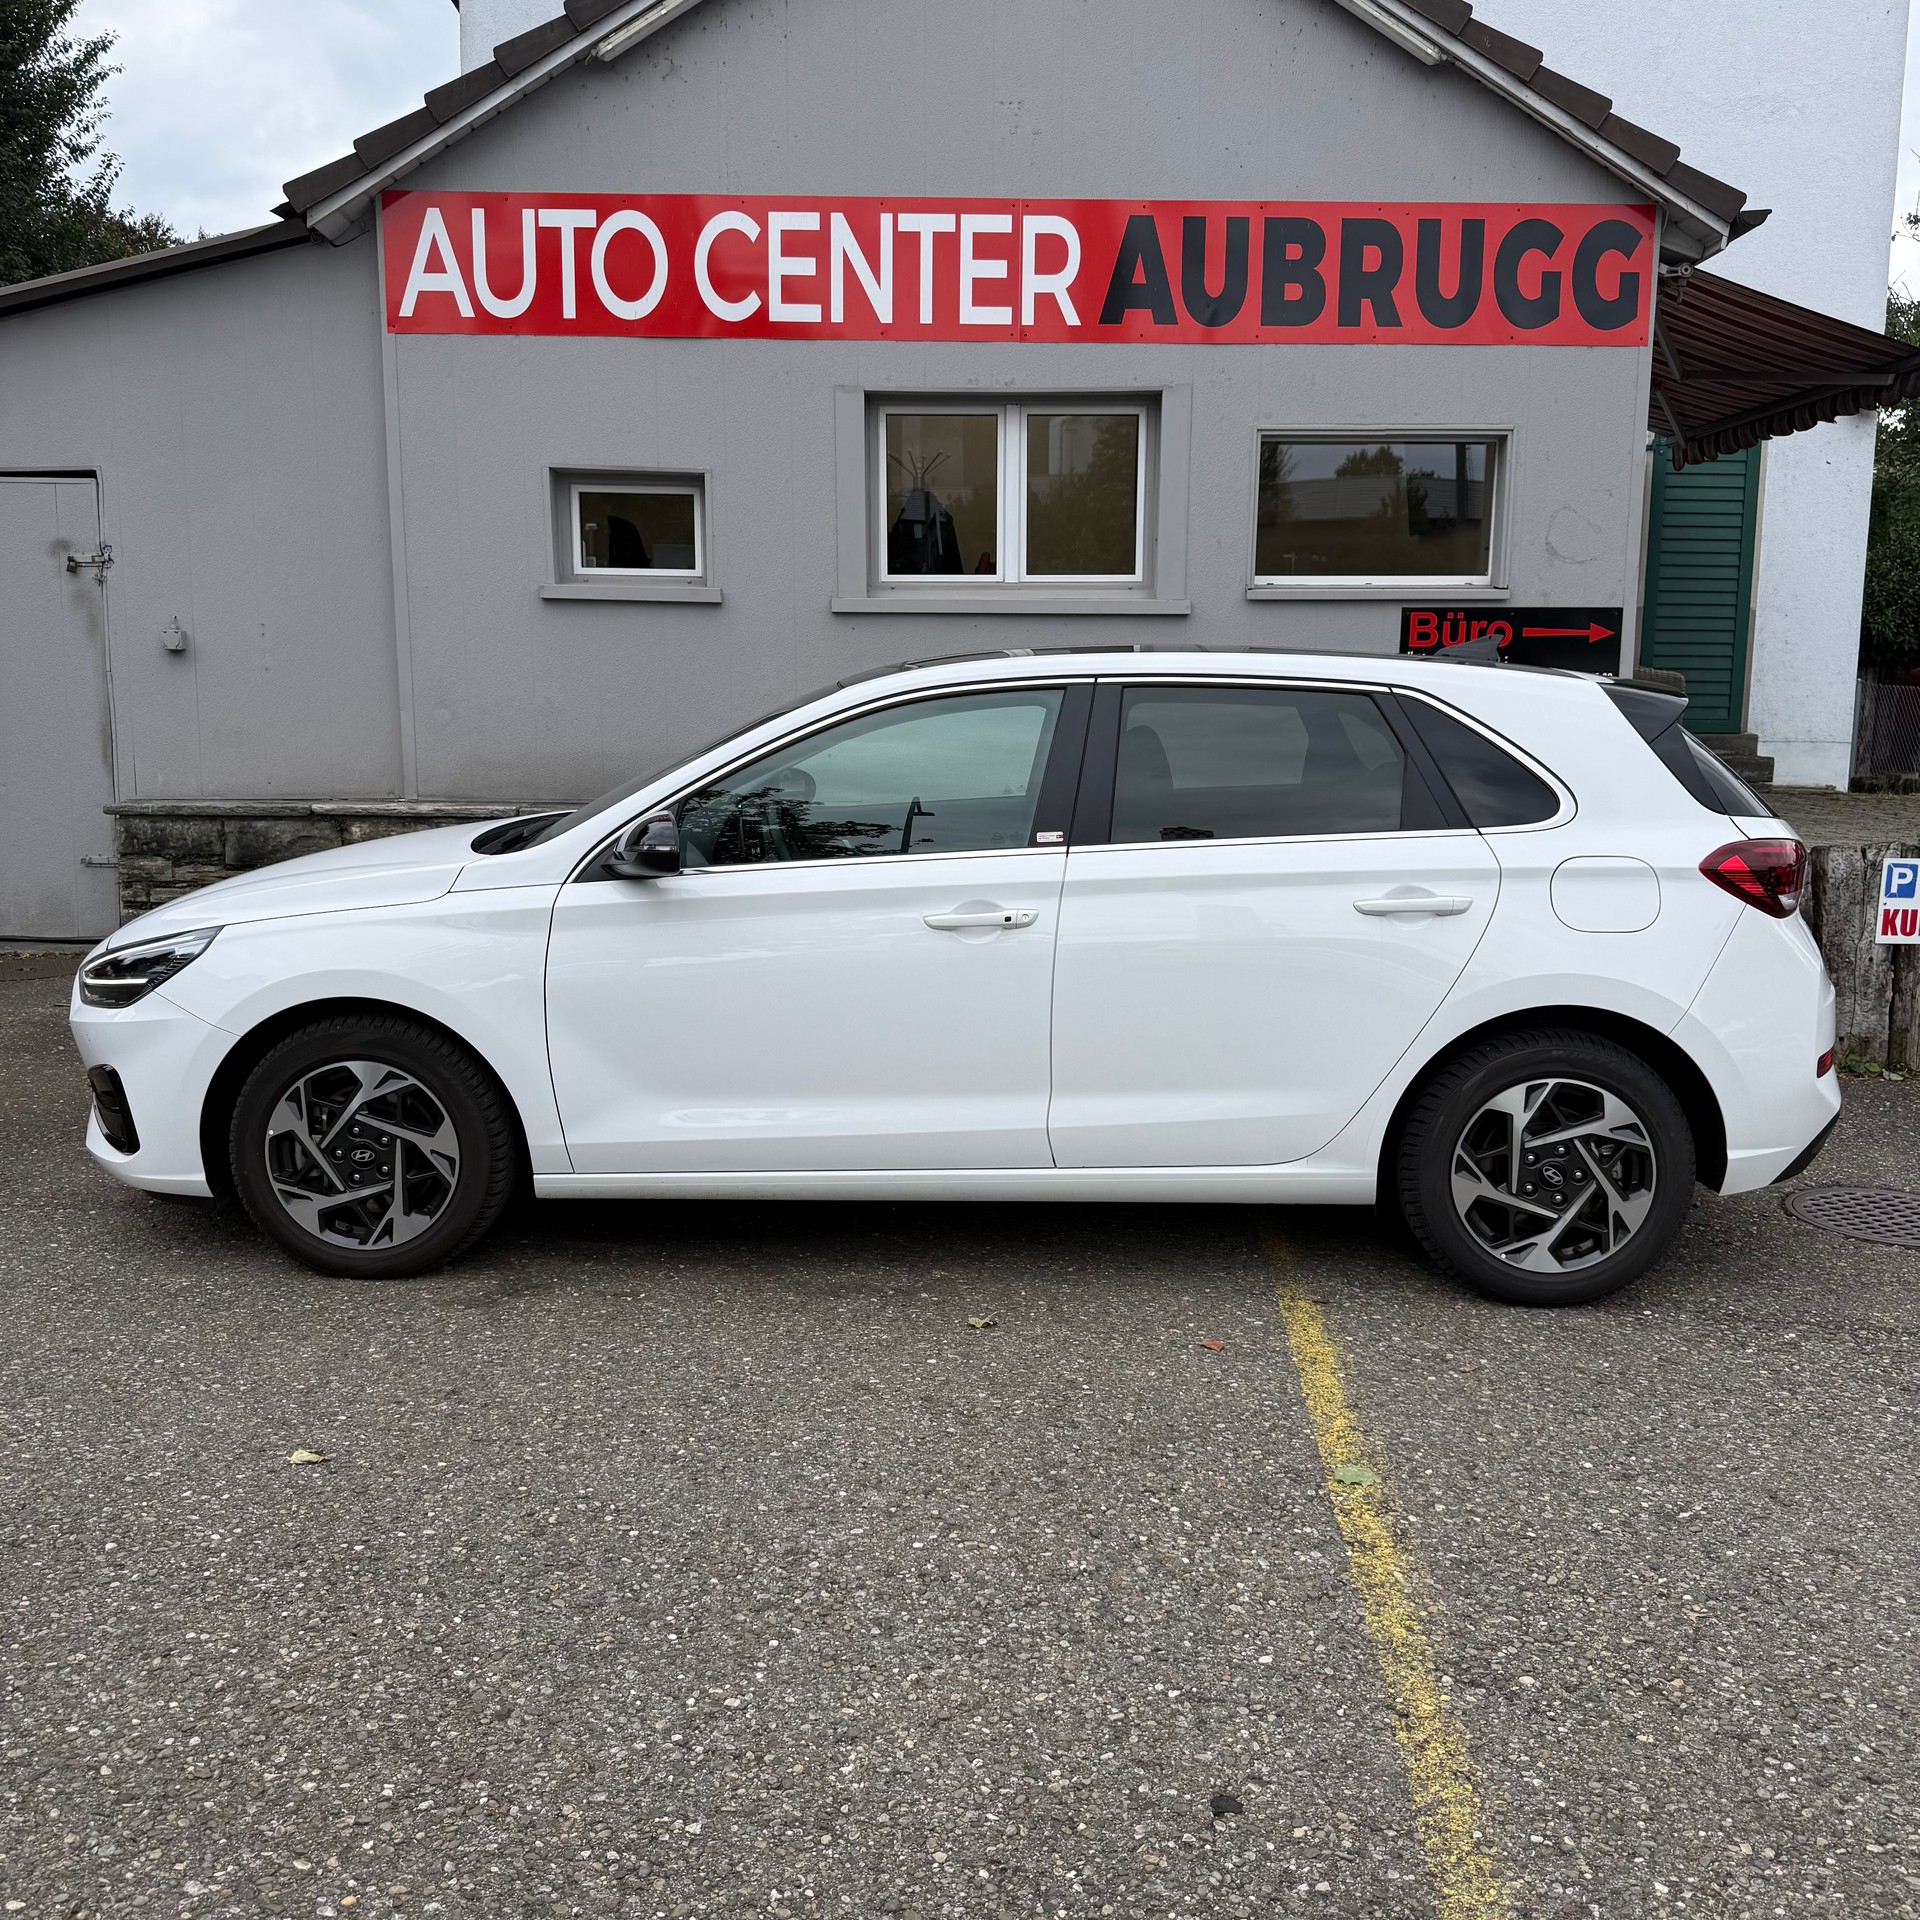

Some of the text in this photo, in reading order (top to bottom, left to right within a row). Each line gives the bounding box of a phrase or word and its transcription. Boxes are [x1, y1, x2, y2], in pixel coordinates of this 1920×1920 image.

[399, 207, 1643, 330] AUTO CENTER AUBRUGG
[1409, 611, 1513, 648] Büro
[1890, 867, 1914, 893] P
[1881, 908, 1920, 936] KU
